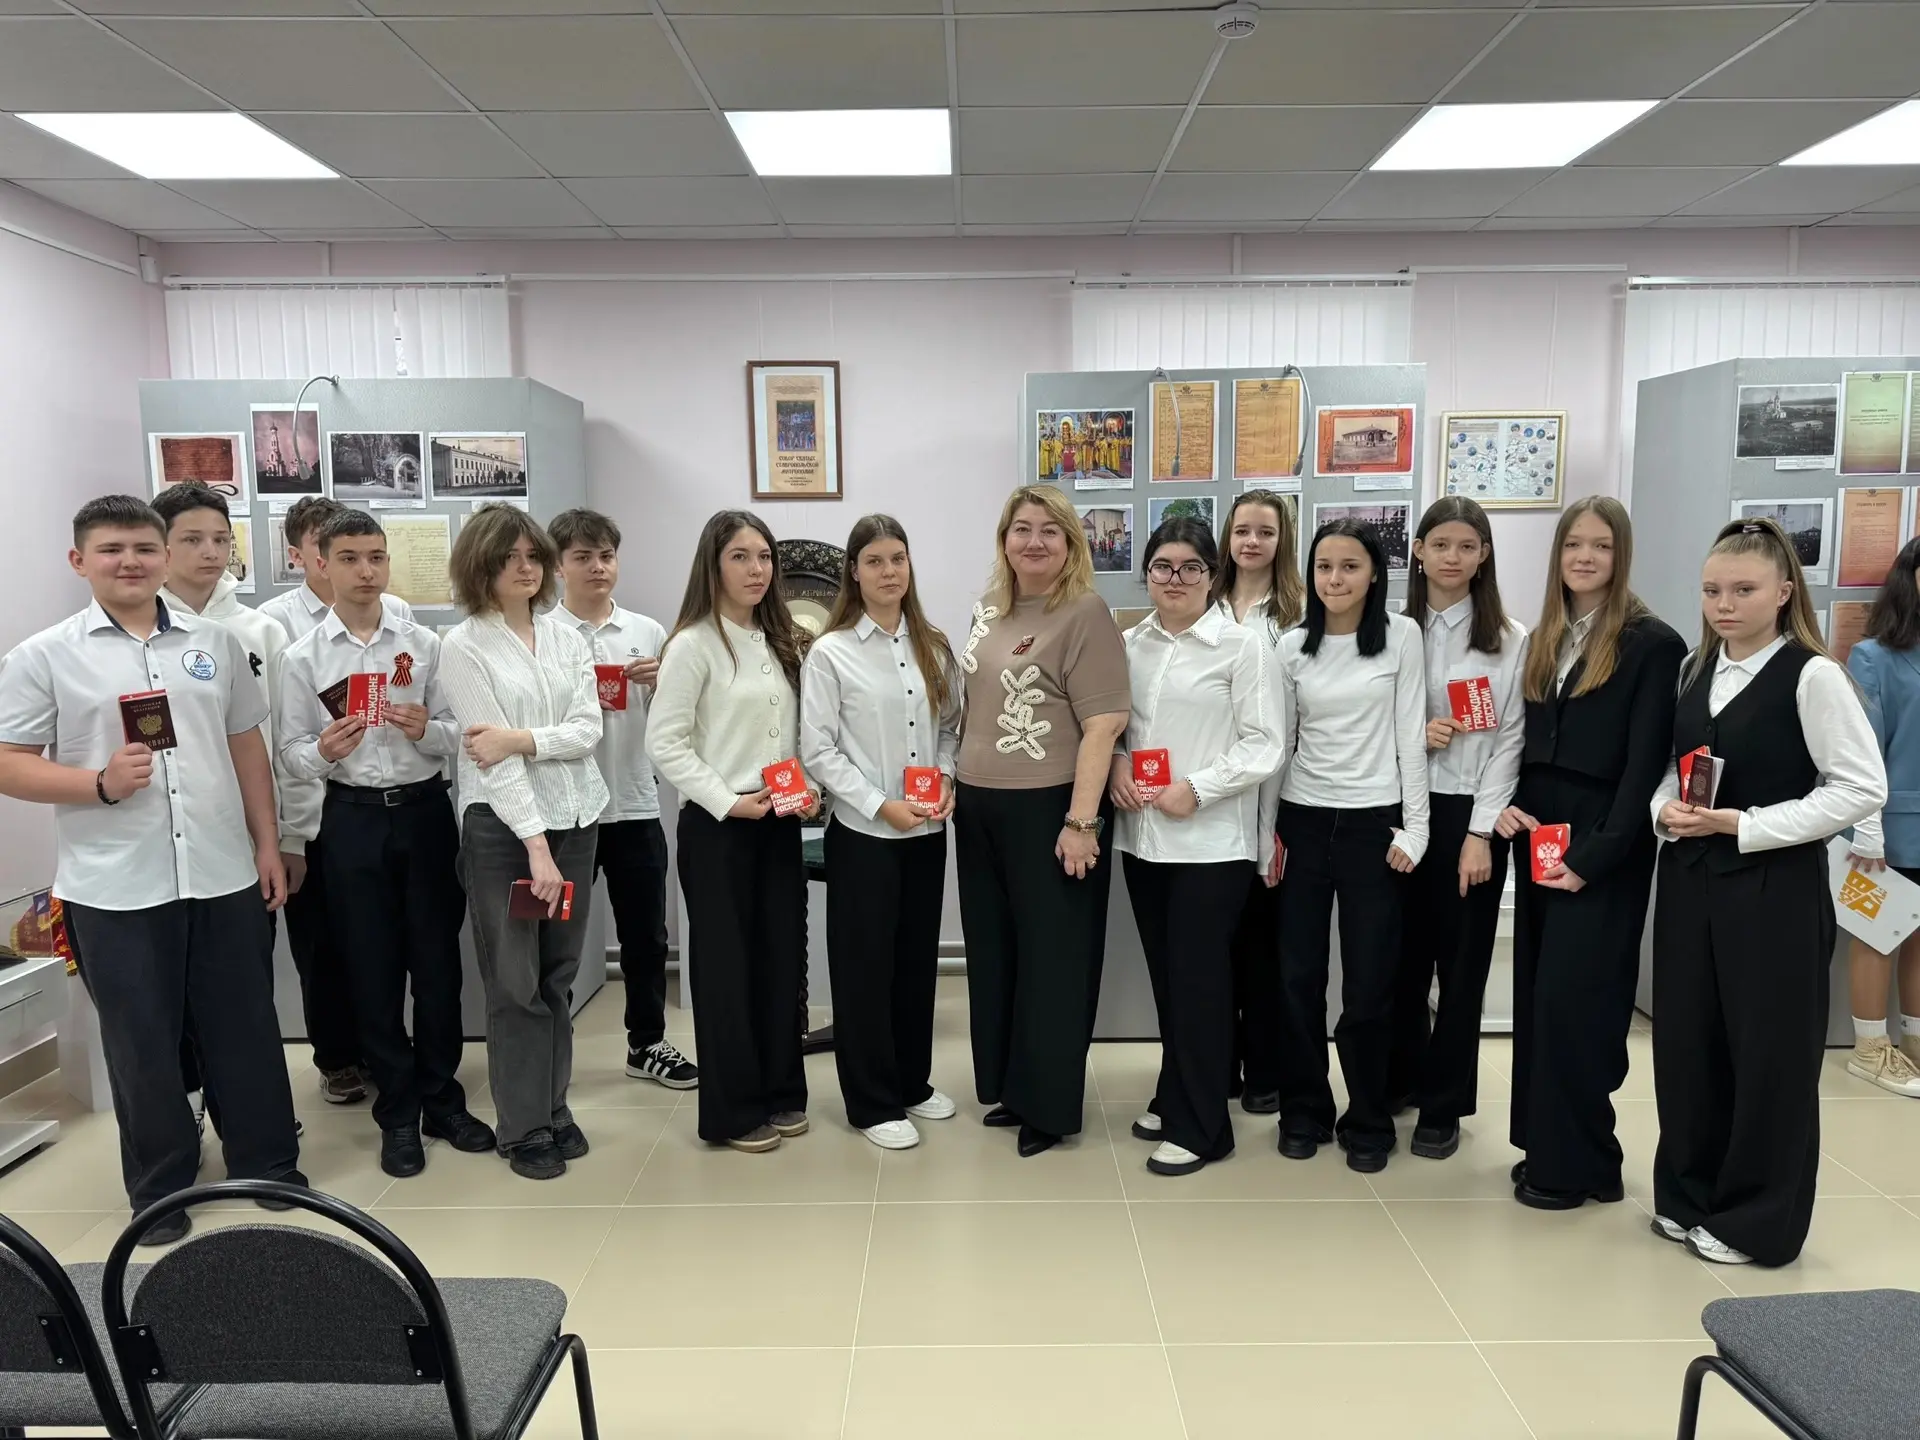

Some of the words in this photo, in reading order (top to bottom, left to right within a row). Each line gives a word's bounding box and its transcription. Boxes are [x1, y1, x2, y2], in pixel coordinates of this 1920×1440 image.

[366, 674, 379, 727] ГРАЖДАНЕ
[1466, 679, 1485, 730] ГРАЖДАНЕ
[1480, 686, 1497, 728] РОССИИ!
[770, 791, 784, 801] МЫ
[772, 790, 809, 807] ГРАЖДАНЕ
[905, 793, 918, 801] МЫ
[775, 799, 804, 813] РОССИИ!
